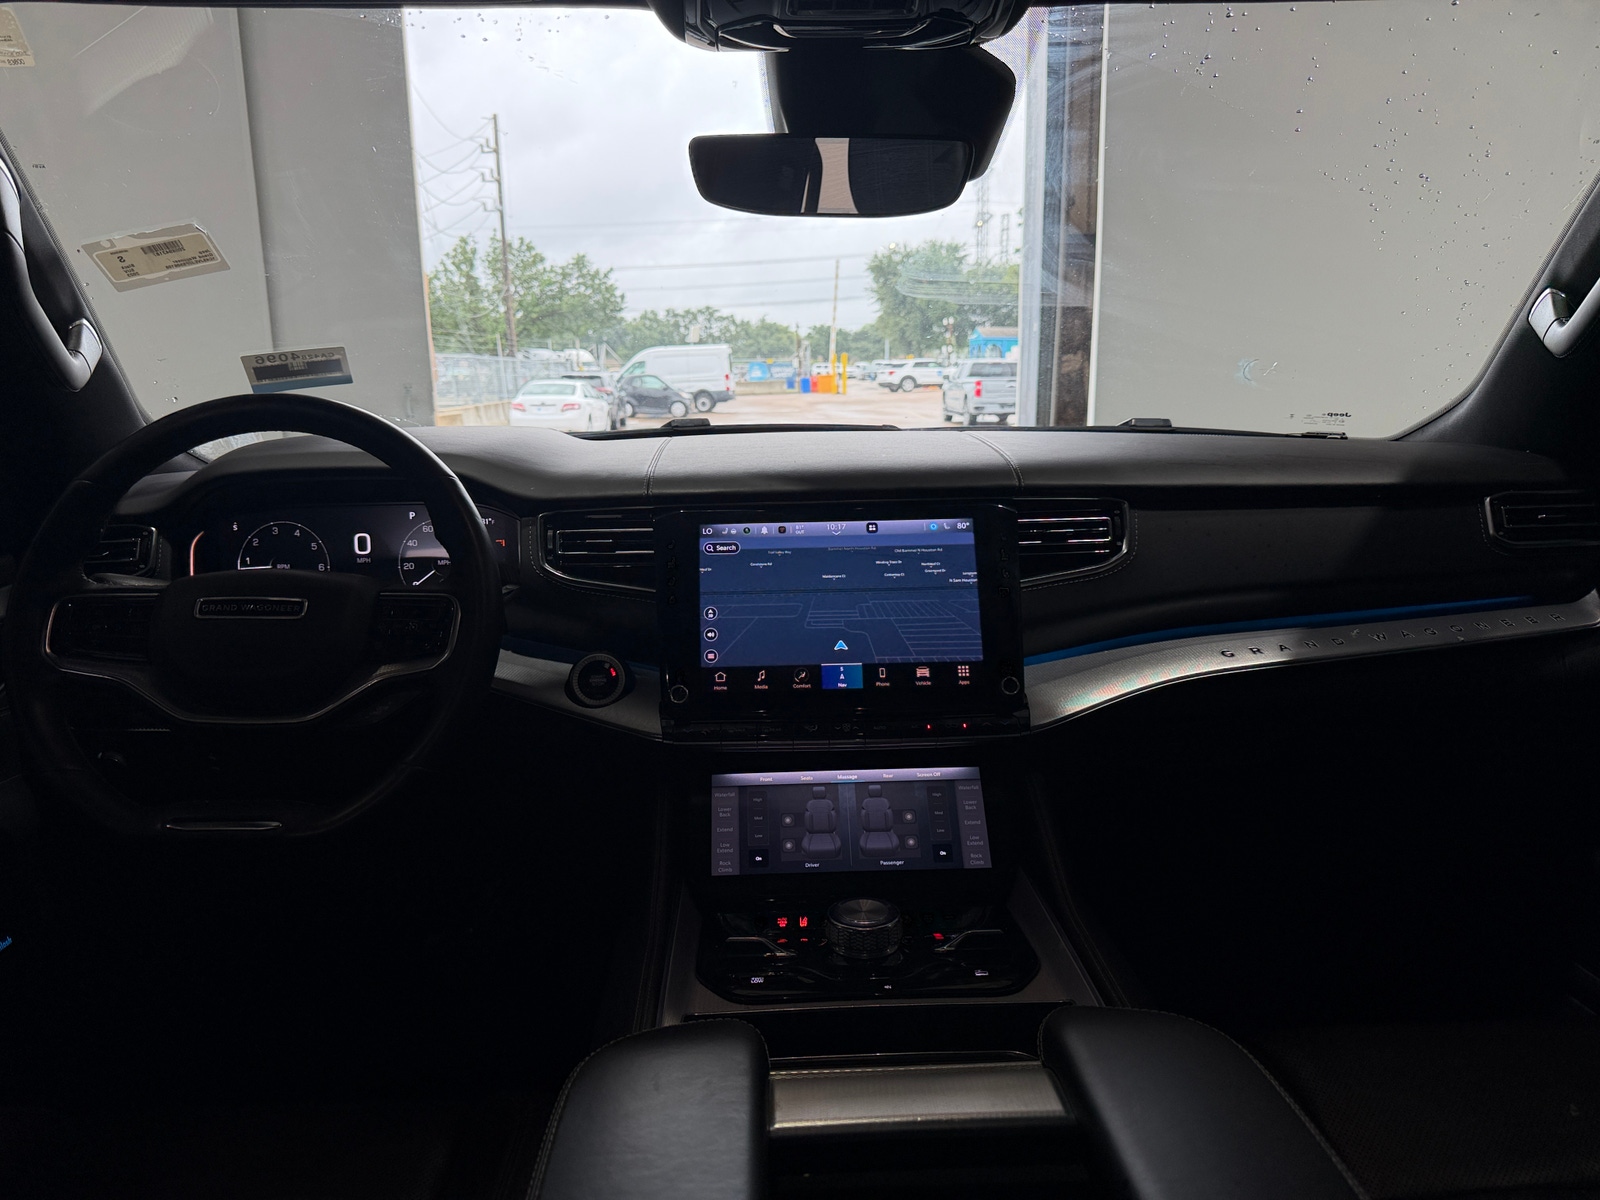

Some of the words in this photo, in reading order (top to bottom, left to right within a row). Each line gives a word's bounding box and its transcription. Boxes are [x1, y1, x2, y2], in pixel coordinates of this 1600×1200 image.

[422, 525, 434, 533] 60
[956, 521, 970, 530] 80°
[272, 527, 279, 535] 3
[294, 529, 301, 537] 4
[252, 538, 259, 547] 2
[353, 532, 373, 555] 0
[407, 539, 418, 547] 40
[311, 543, 318, 551] 5
[246, 557, 251, 565] 1
[318, 563, 326, 571] 6
[403, 562, 415, 570] 20
[201, 602, 238, 612] GRAND
[240, 603, 301, 612] WAGONEER
[1220, 636, 1345, 658] GRAND
[1370, 612, 1566, 642] WAGONEER
